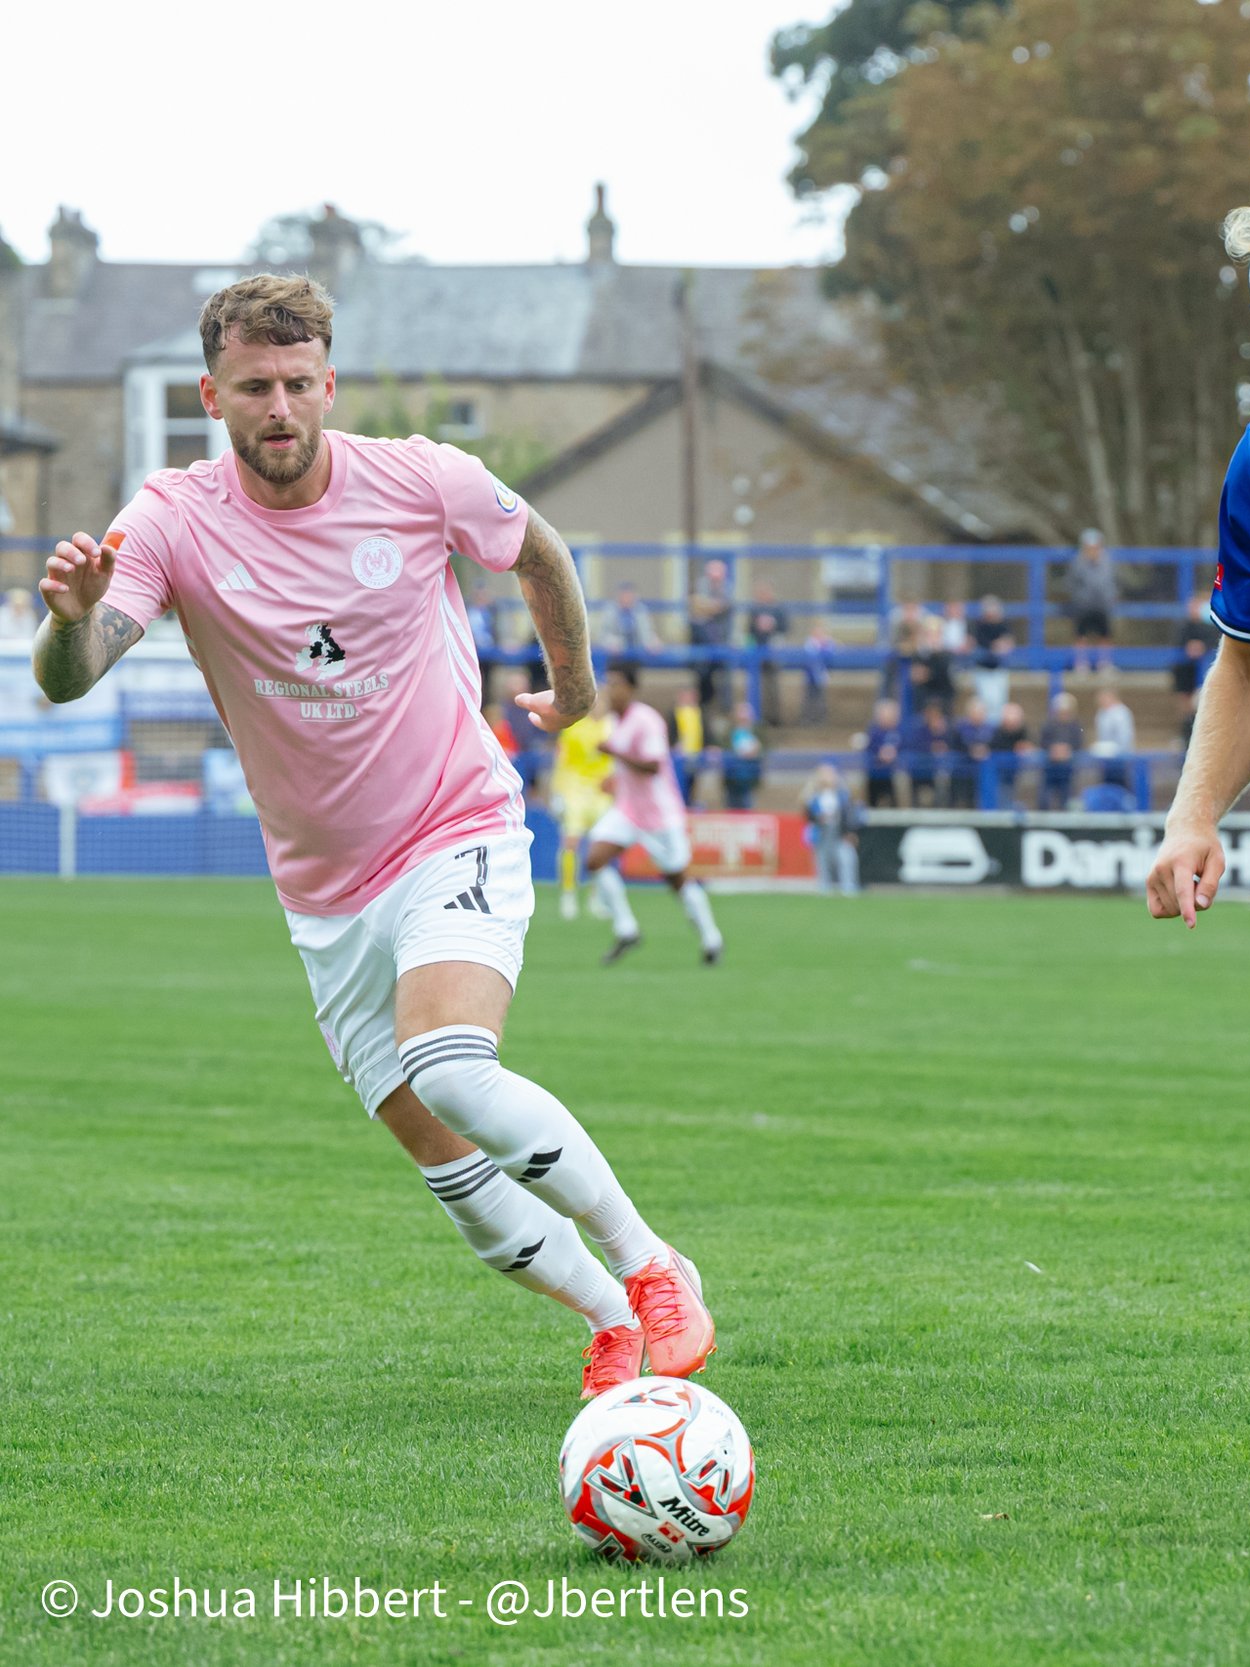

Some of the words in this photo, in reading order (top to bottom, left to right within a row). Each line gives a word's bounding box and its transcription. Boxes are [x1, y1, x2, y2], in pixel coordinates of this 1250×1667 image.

[254, 679, 330, 697] REGIONAL
[333, 673, 389, 697] STEELS
[300, 702, 323, 719] UK
[326, 703, 359, 719] LTD.
[454, 846, 488, 886] 7
[1021, 825, 1156, 888] Dani
[657, 1496, 710, 1537] Mitre
